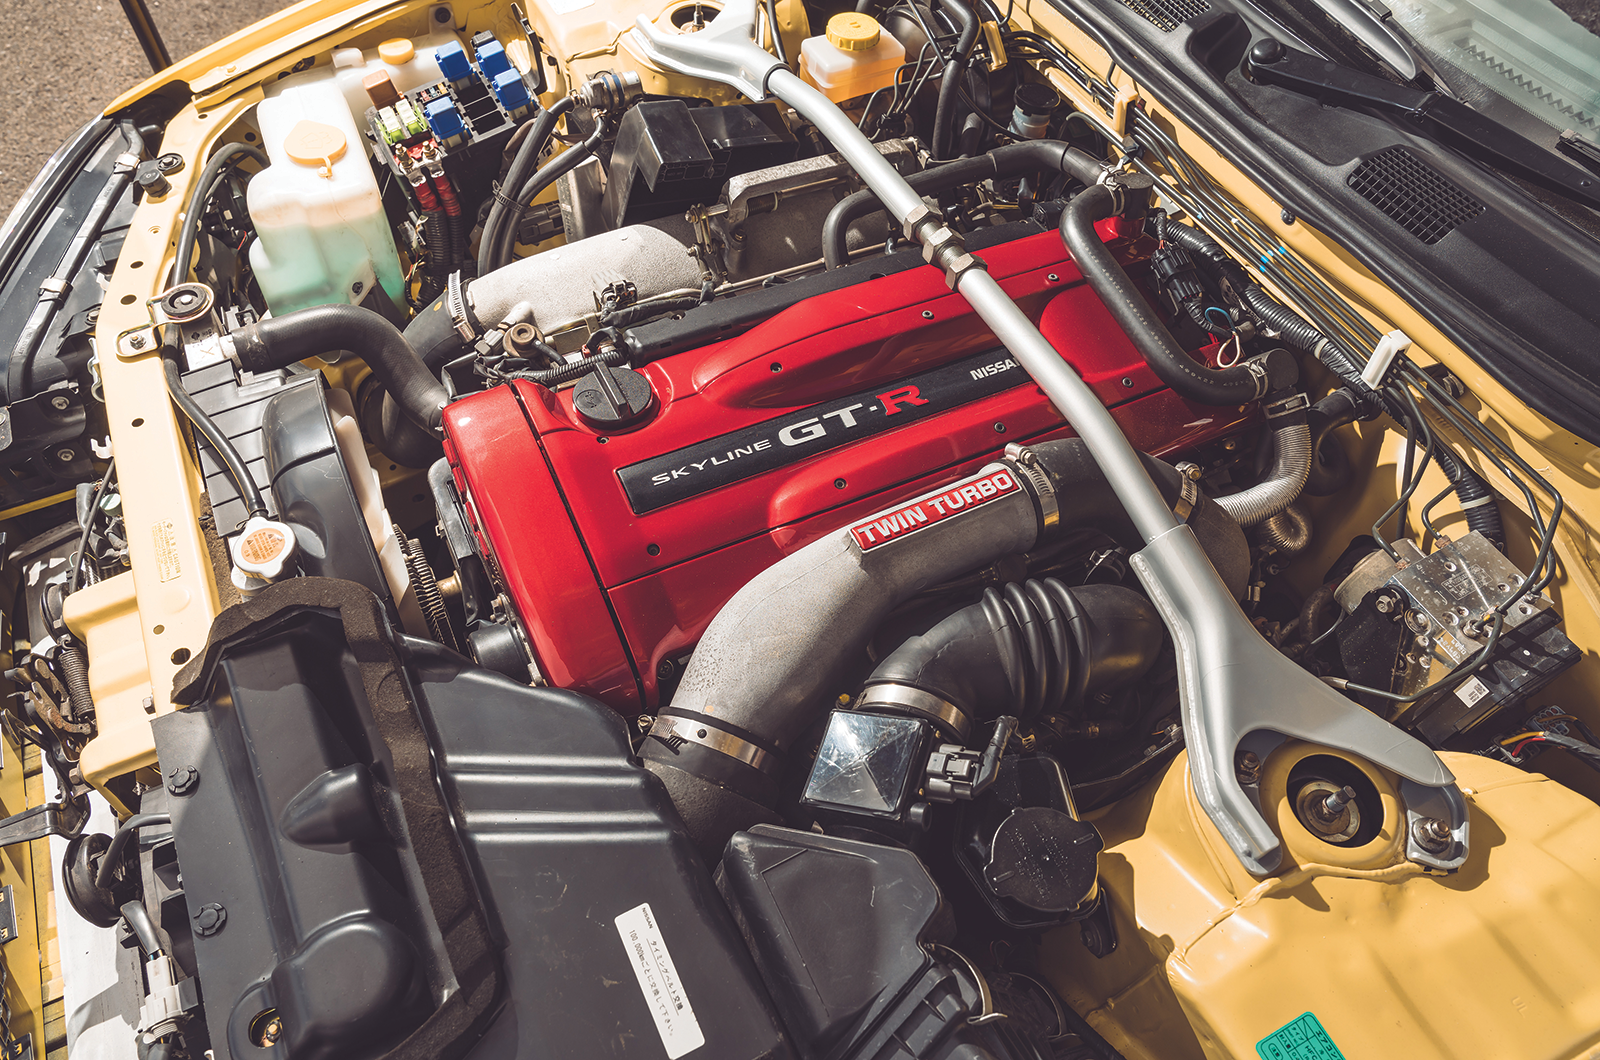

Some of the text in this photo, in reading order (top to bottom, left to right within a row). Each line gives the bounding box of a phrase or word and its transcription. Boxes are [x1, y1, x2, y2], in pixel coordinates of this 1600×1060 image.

[650, 439, 773, 486] SKYLINE
[969, 356, 1021, 381] NISSA
[855, 470, 1016, 545] TWIN TURBO
[641, 907, 653, 929] NISSAN
[650, 940, 684, 1011] タイミングベルト交換
[1315, 1030, 1342, 1060] エアコン
